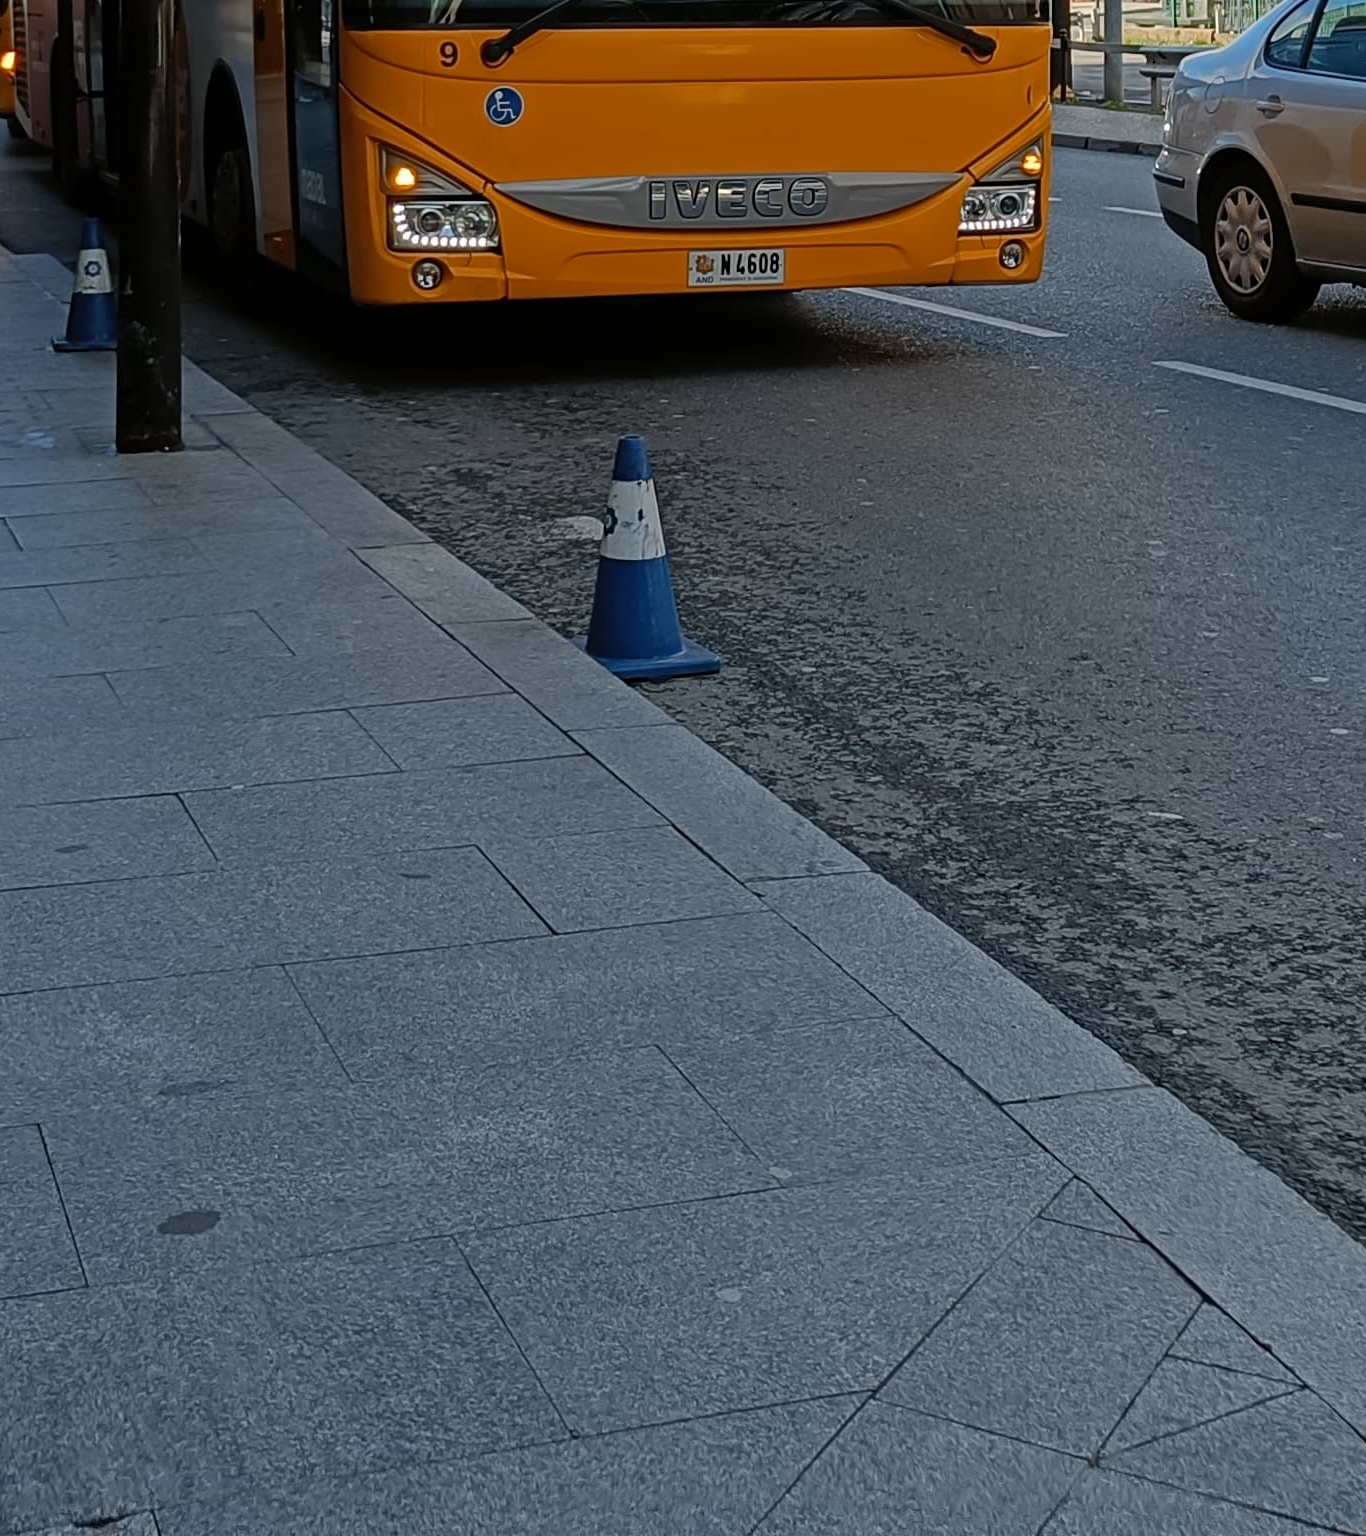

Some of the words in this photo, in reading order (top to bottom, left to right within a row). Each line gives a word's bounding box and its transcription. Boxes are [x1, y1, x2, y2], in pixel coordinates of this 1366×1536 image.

[440, 42, 459, 67] 9
[648, 176, 829, 220] IVECO
[696, 276, 714, 284] AND
